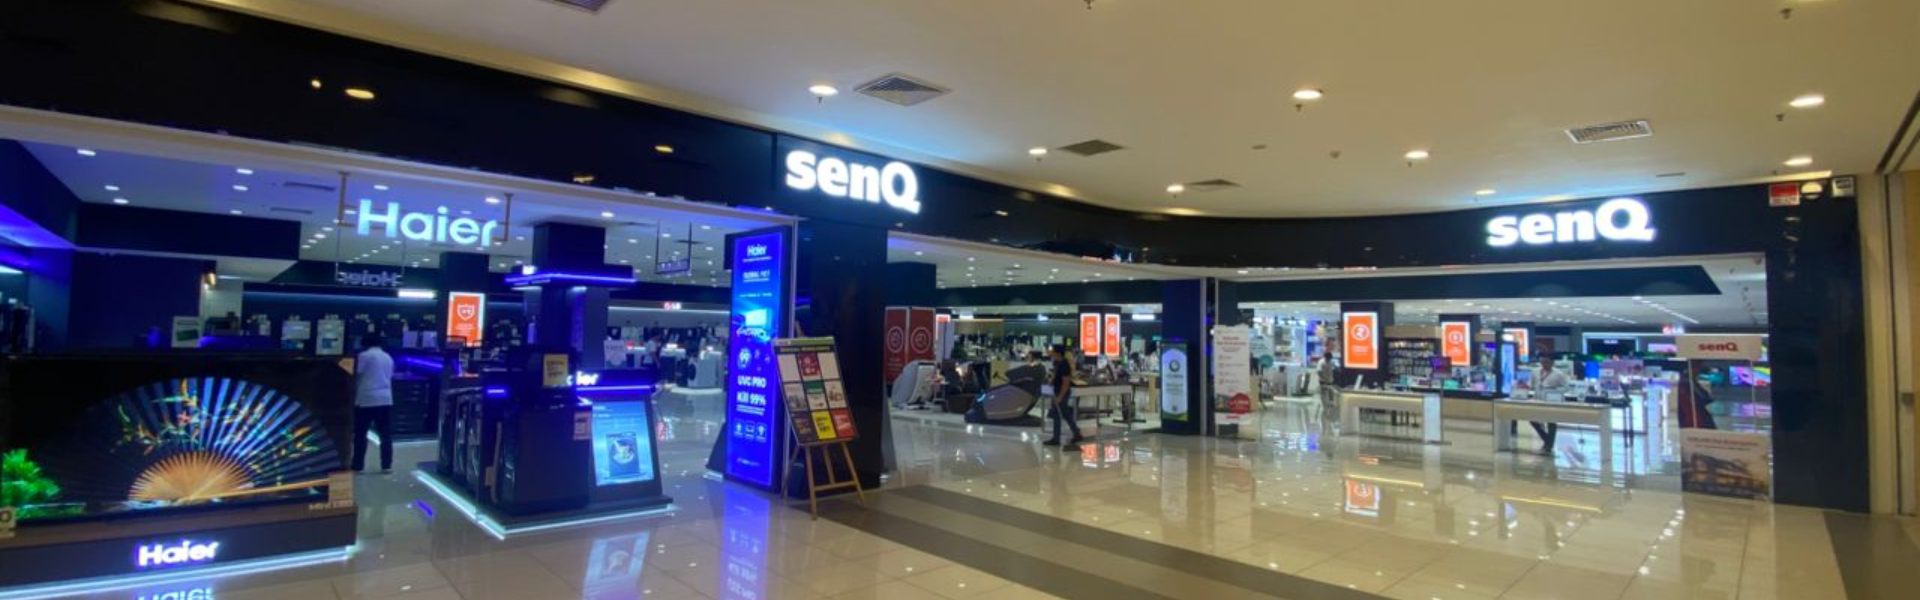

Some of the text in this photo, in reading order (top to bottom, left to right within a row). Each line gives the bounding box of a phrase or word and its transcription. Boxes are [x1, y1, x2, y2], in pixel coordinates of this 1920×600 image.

[786, 150, 921, 214] senQ
[358, 199, 497, 247] Haier
[1486, 198, 1656, 246] senQ
[1698, 341, 1738, 352] senQ
[138, 540, 219, 567] Haier
